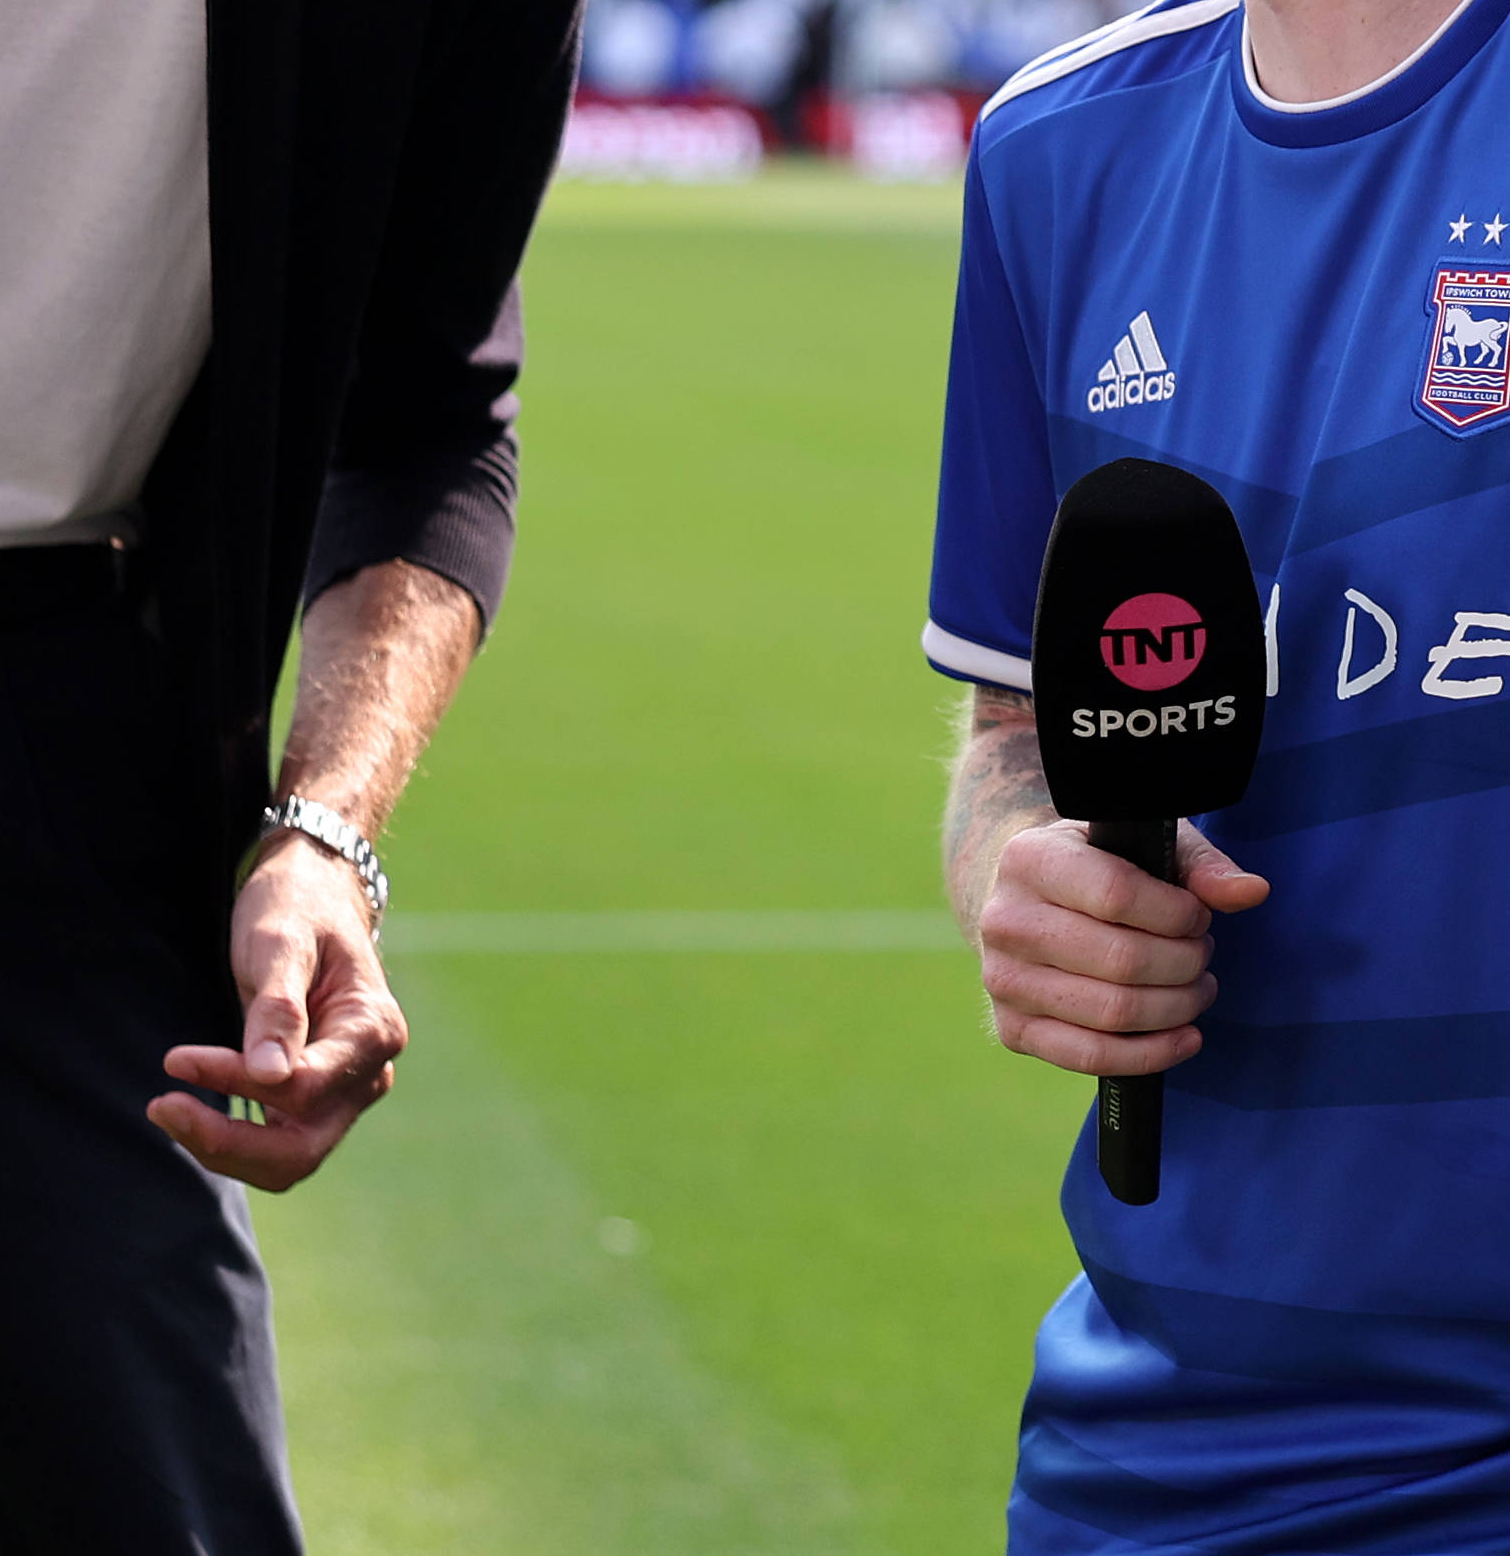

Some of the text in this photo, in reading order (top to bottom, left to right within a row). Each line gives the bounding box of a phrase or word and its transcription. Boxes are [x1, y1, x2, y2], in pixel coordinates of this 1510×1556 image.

[1445, 287, 1483, 298] IPSWICH
[1088, 371, 1175, 413] adidas
[1431, 389, 1499, 402] FOOTBALL CLUB
[1101, 621, 1206, 666] TNT
[1072, 695, 1236, 738] SPORTS
